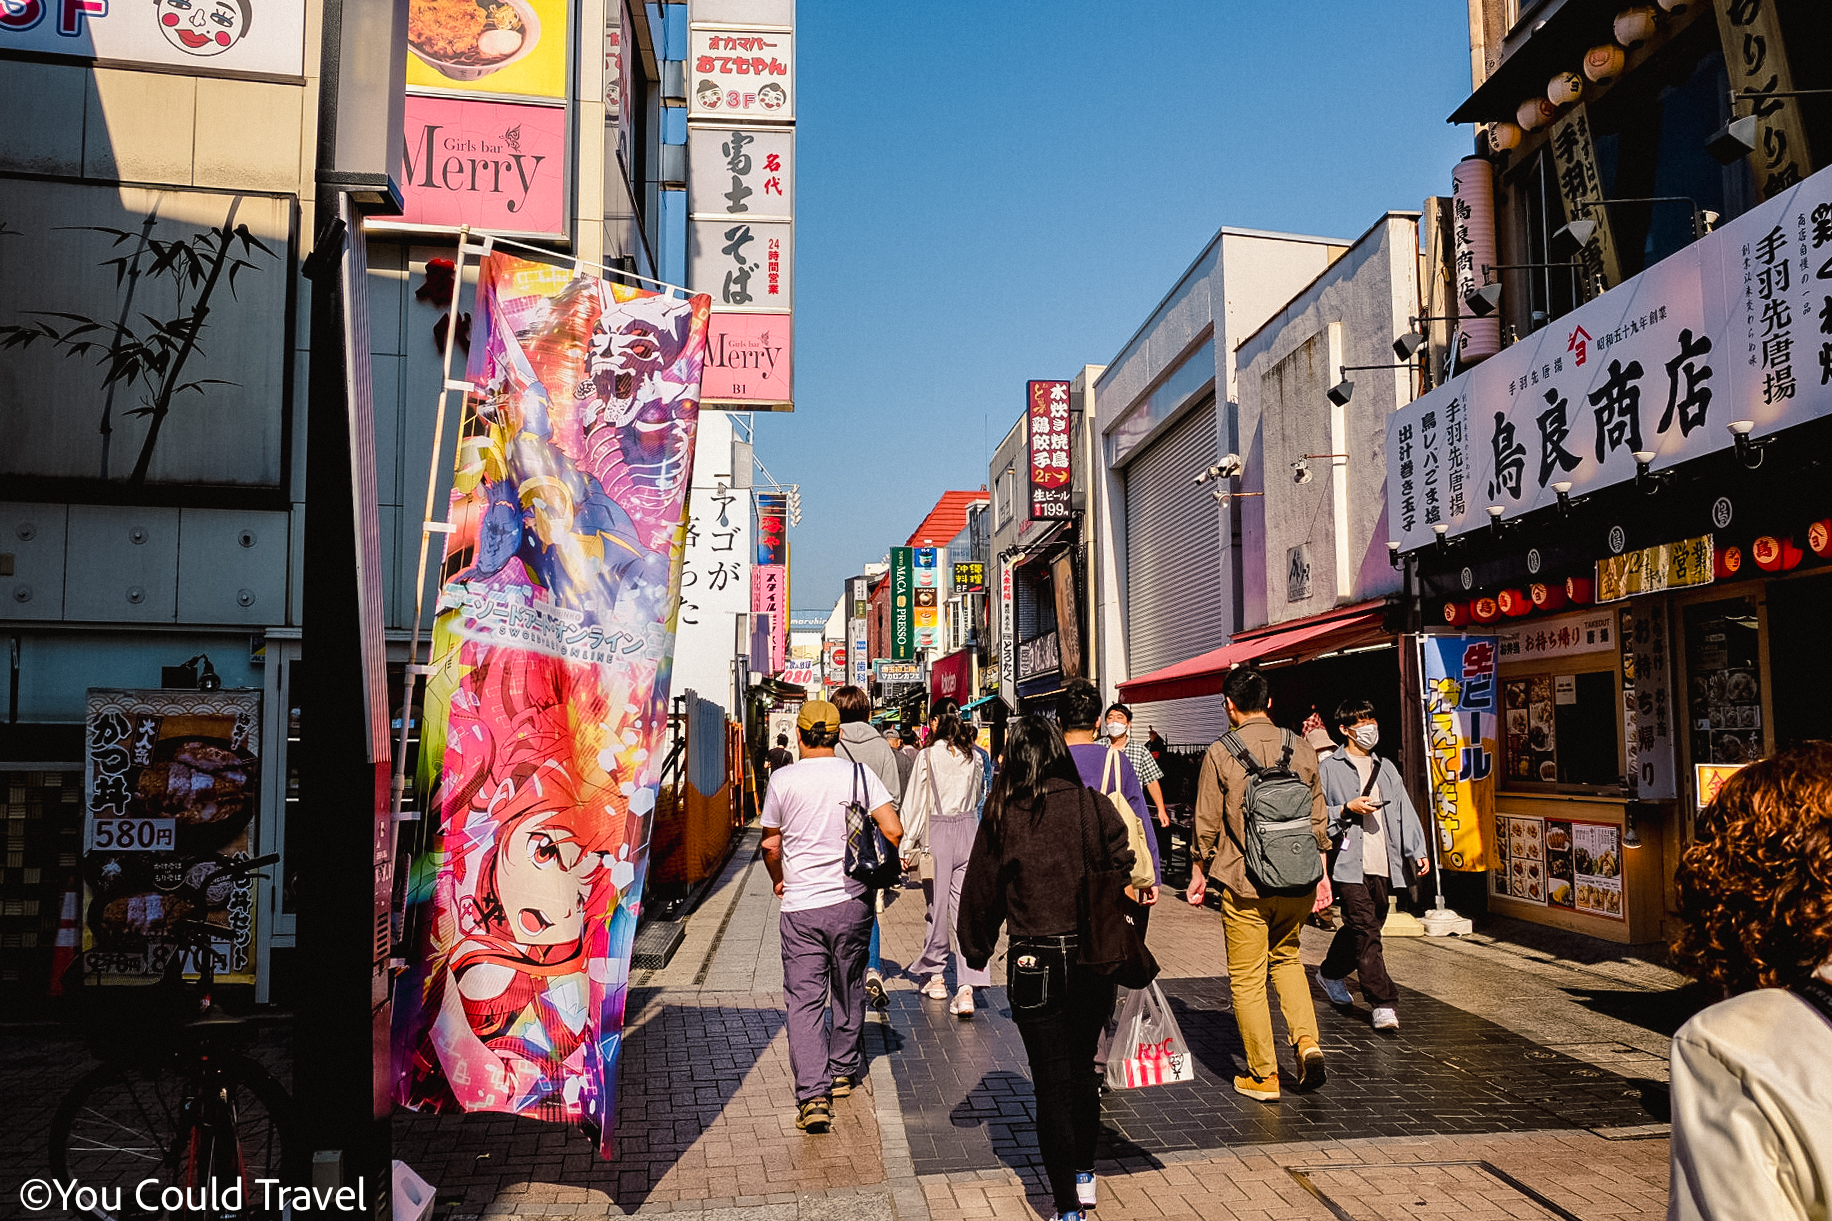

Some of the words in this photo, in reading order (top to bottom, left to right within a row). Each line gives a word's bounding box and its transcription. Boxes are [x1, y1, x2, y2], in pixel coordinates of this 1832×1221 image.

[696, 55, 787, 76] おてもやん
[708, 35, 777, 51] オカマバー
[726, 90, 756, 109] 3F
[443, 137, 476, 152] Girls
[481, 140, 503, 154] bar
[402, 125, 546, 213] Merry
[722, 131, 755, 214] 富士
[762, 152, 783, 196] 名代
[721, 225, 760, 305] そば
[767, 238, 780, 295] 24時間営業
[1596, 304, 1668, 351] 昭和五十九年創業
[1754, 225, 1796, 405] 手羽先唐揚
[703, 333, 782, 379] Merry
[728, 339, 748, 348] Girls
[732, 383, 746, 395] B1
[1508, 356, 1563, 397] 手羽先唐揚
[1487, 328, 1713, 501] 鳥良商店
[1035, 469, 1052, 483] 2F
[1421, 410, 1441, 525] 鳥レバごま塩
[1445, 397, 1465, 518] 手羽先唐揚
[1033, 488, 1070, 502] 生ビール
[708, 495, 741, 591] アゴが
[896, 608, 907, 645] PRESSO
[1525, 627, 1580, 652] お持ち帰り
[560, 645, 614, 664] ONLINE
[1459, 641, 1495, 782] 生ビール
[1635, 618, 1656, 788] お持ち帰り
[89, 711, 132, 816] かつ丼
[133, 719, 156, 766] 大人気
[95, 819, 173, 849] 580円
